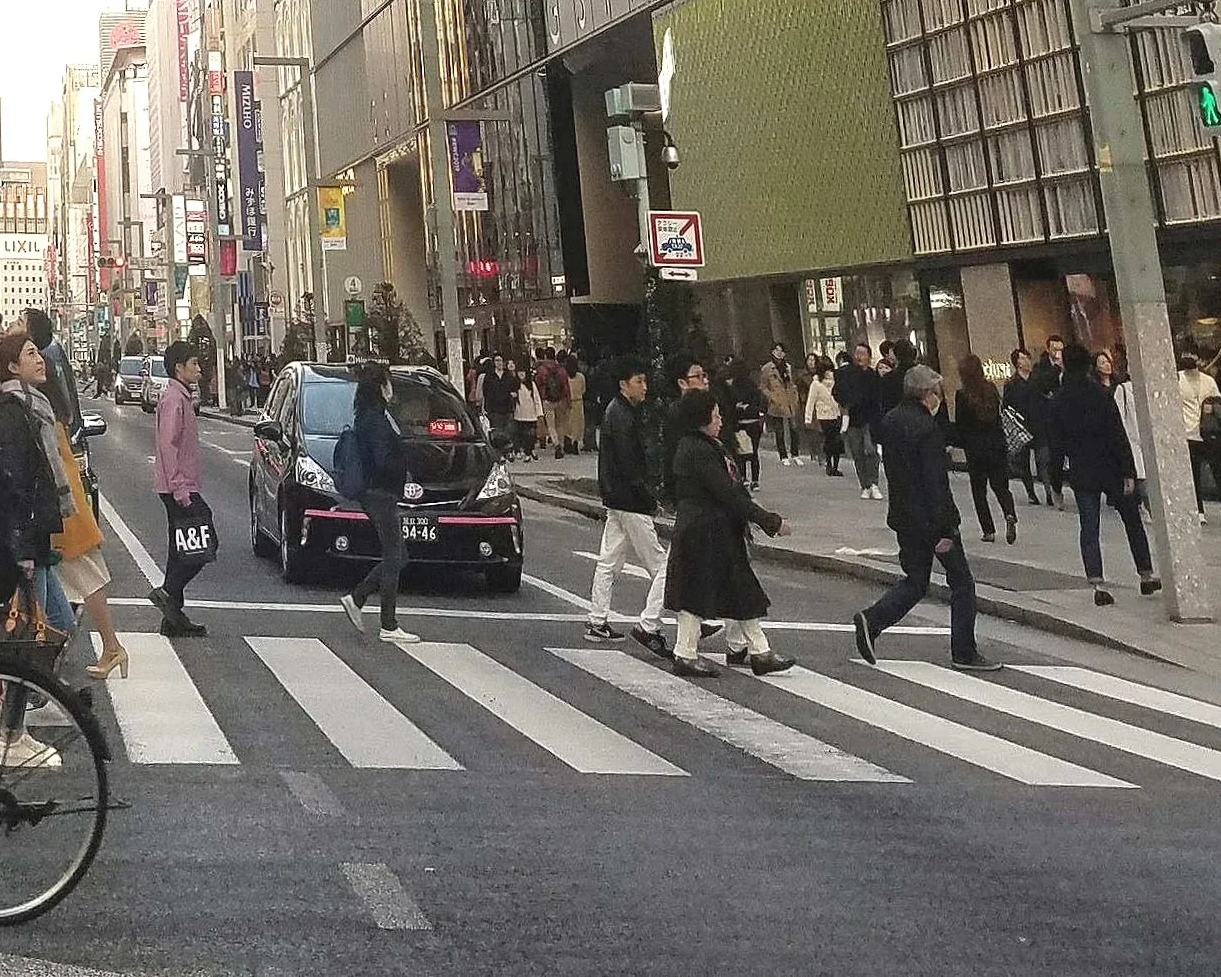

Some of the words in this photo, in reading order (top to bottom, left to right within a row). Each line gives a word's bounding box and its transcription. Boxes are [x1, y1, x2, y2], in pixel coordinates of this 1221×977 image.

[241, 84, 253, 129] MIZUHO
[4, 240, 41, 253] LIXIL
[175, 525, 210, 552] A&F
